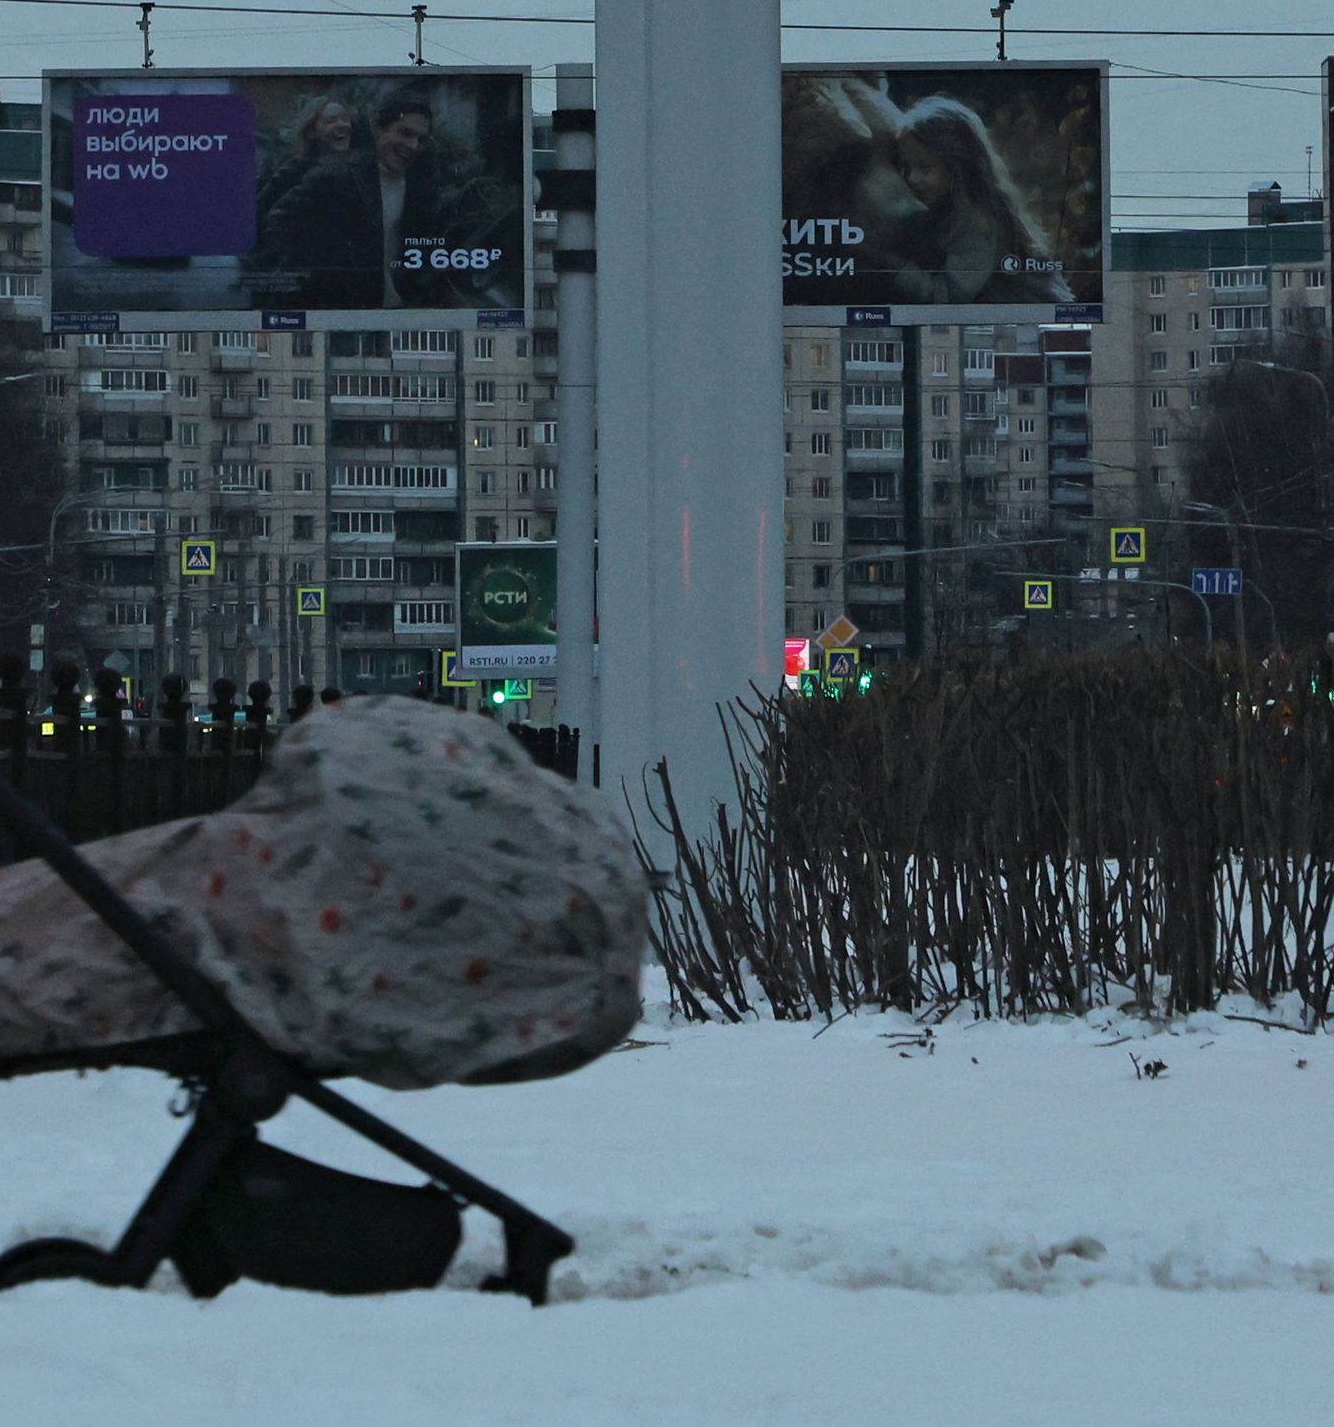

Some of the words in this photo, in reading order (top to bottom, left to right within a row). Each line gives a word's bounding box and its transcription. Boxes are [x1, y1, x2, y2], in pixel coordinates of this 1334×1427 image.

[86, 107, 159, 126] люди
[86, 129, 228, 157] выбирают
[86, 163, 120, 180] на
[127, 158, 169, 180] wb
[404, 237, 446, 246] пальто
[782, 219, 865, 245] ИТЬ
[404, 248, 423, 269] 3
[1025, 258, 1063, 271] Russ
[484, 590, 528, 605] РСТИ
[469, 657, 508, 666] RSTI.RU
[517, 656, 536, 665] 220
[539, 656, 551, 665] 27
